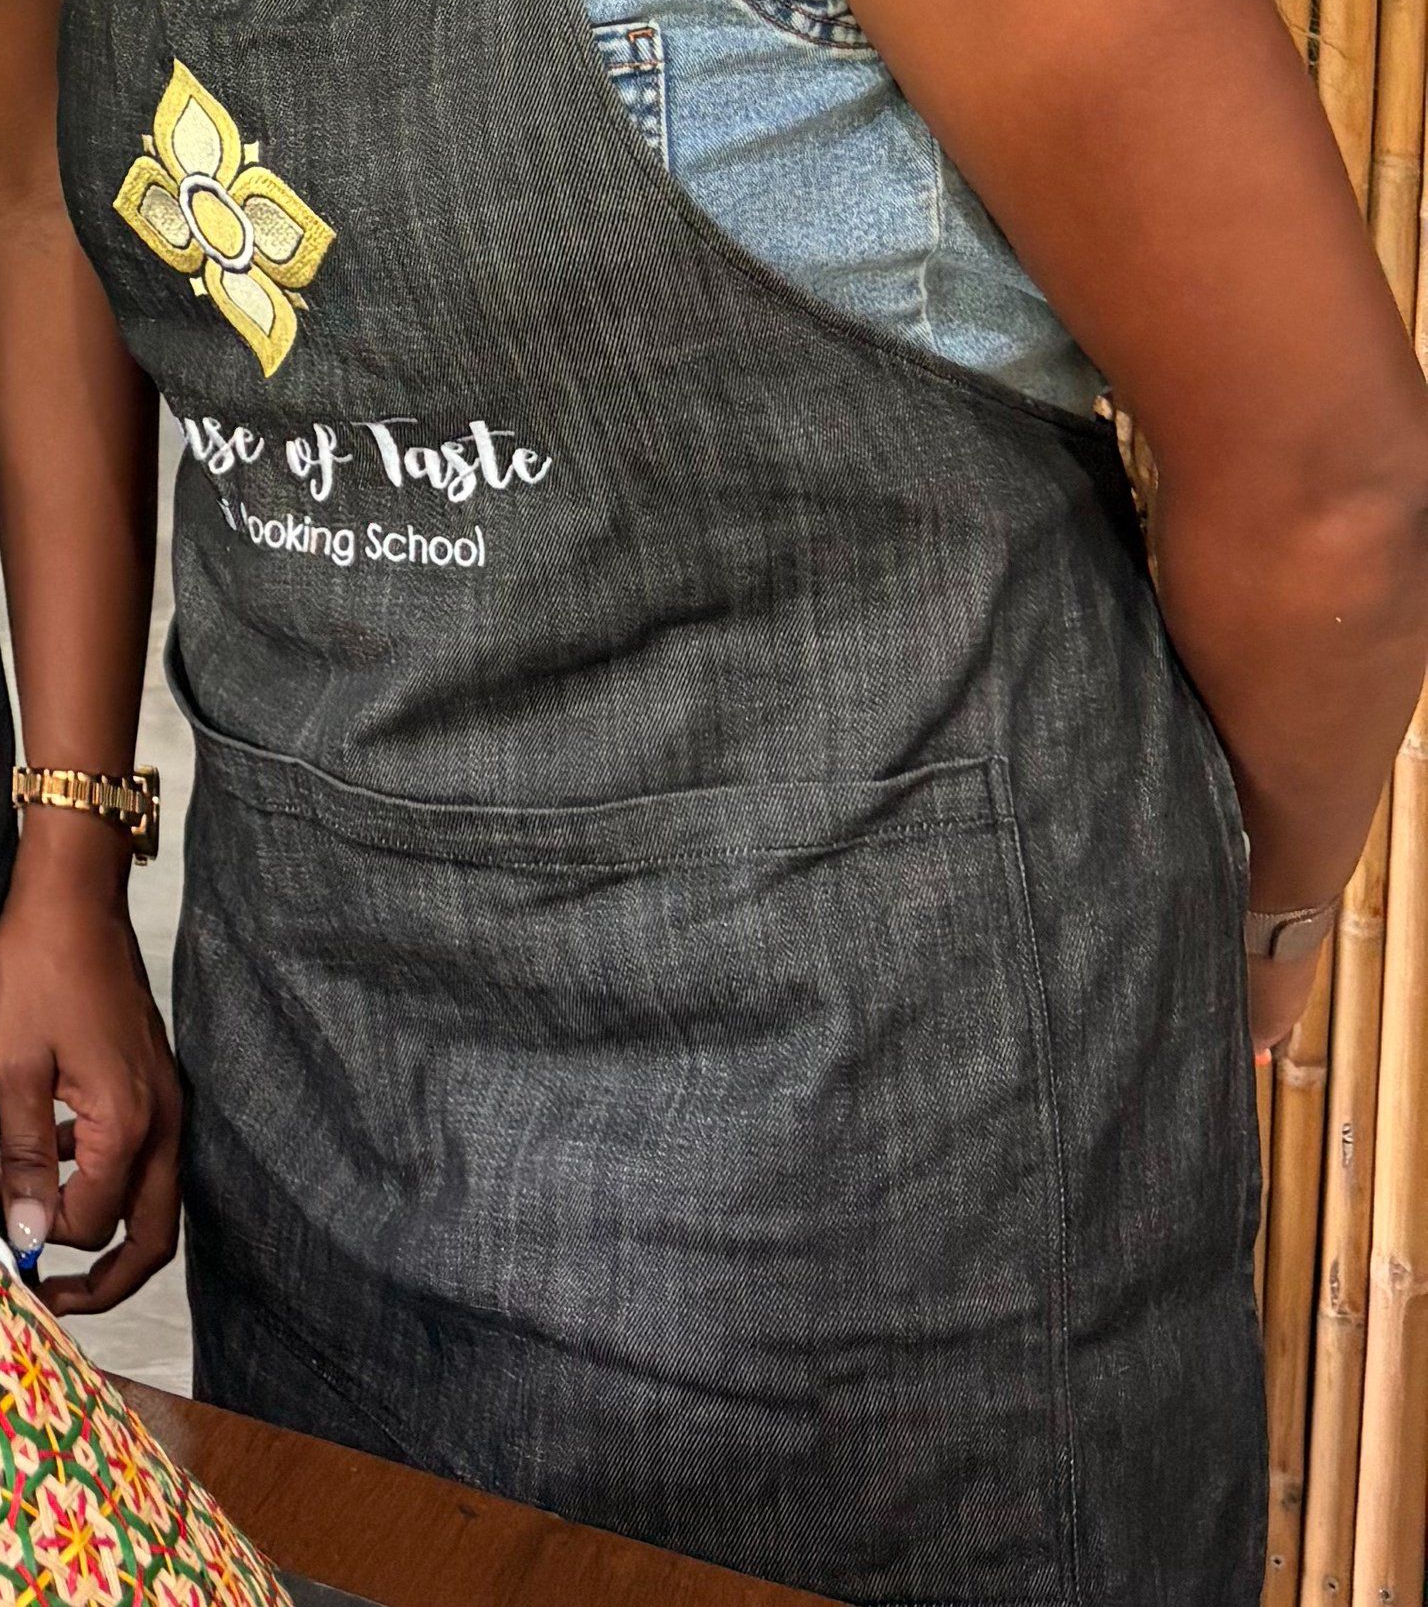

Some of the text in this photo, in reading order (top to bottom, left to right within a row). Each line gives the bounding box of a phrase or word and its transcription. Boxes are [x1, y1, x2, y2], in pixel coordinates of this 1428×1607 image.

[183, 415, 553, 503] use of Taste
[240, 502, 355, 567] ooking
[364, 521, 485, 568] School
